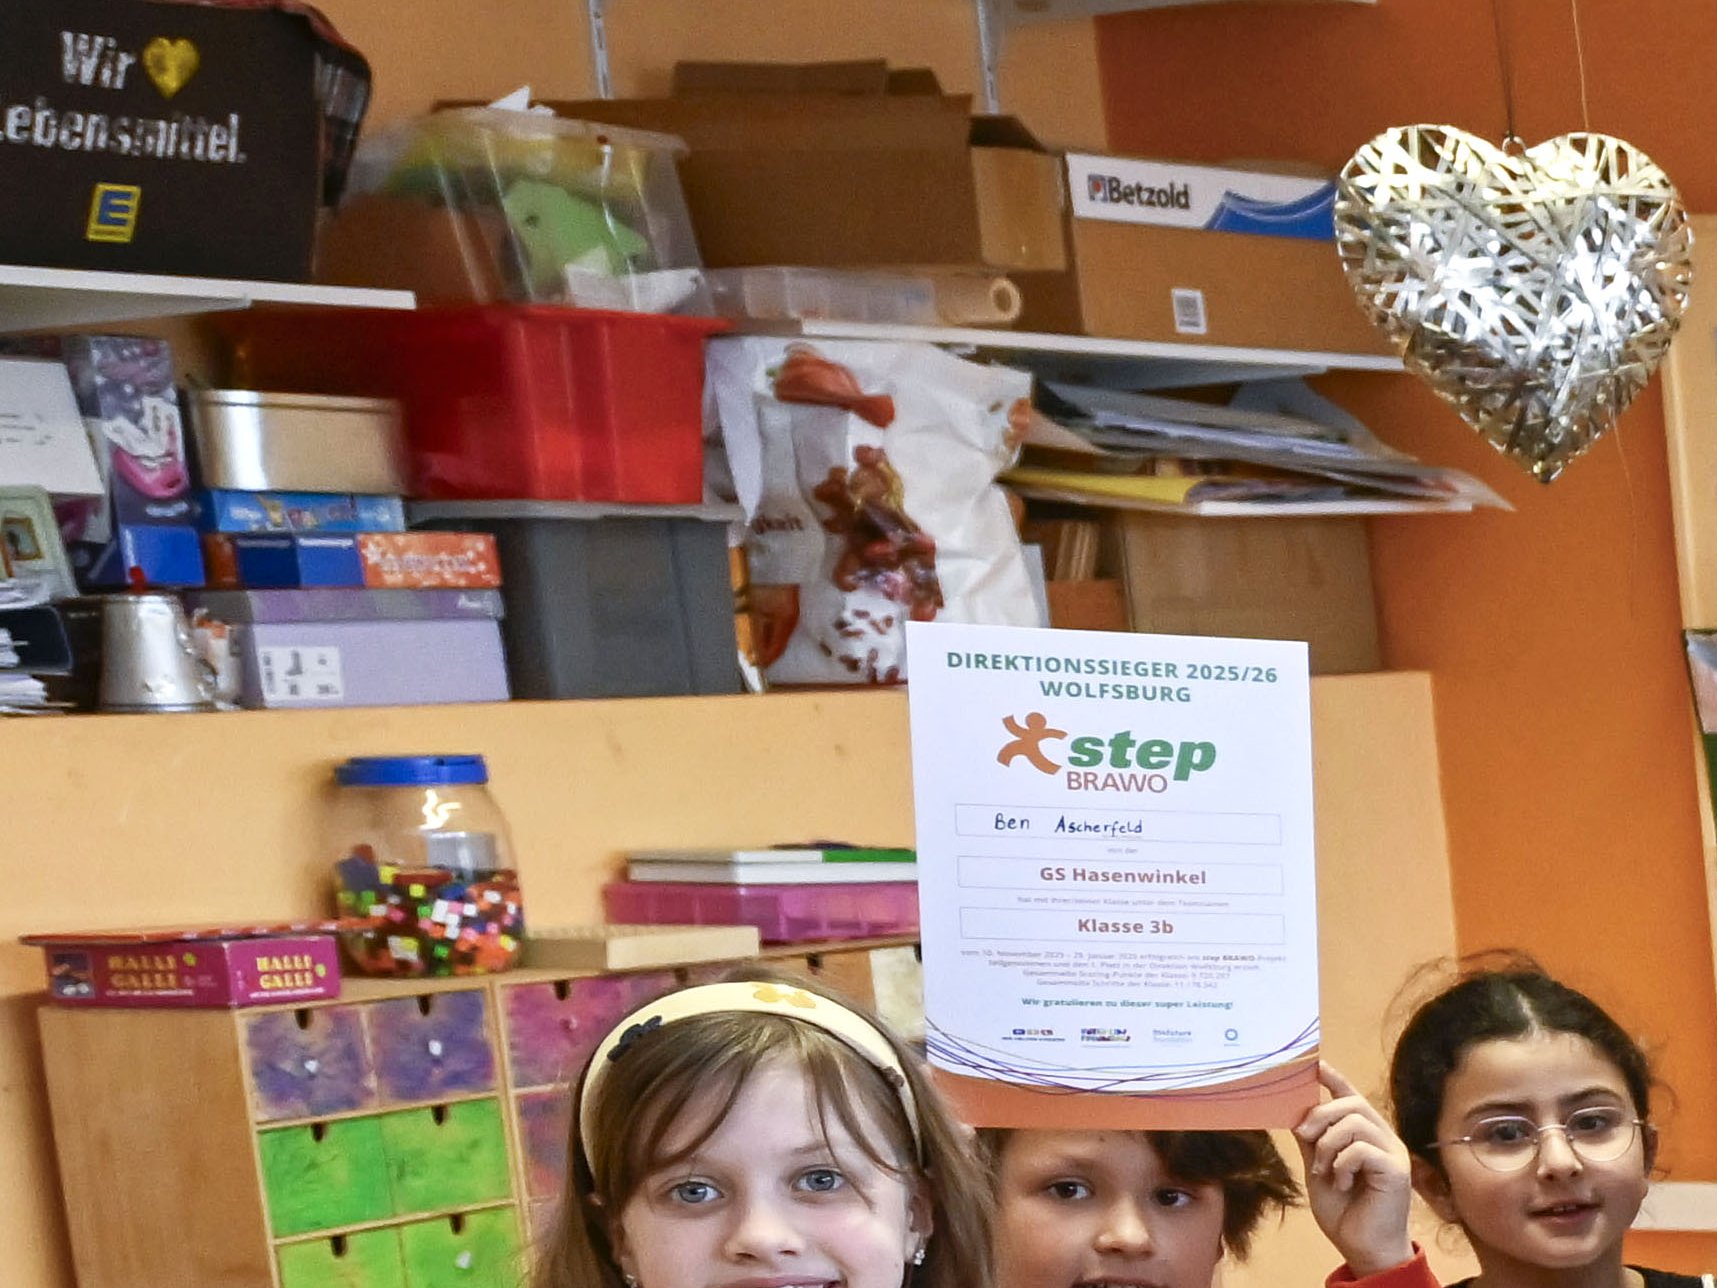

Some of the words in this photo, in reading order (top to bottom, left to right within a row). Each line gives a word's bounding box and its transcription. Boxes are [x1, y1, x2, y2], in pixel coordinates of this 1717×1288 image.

[61, 31, 136, 90] Wir
[0, 97, 247, 163] ebensmittel.
[1107, 173, 1190, 211] Betzold
[995, 813, 1030, 830] Ben
